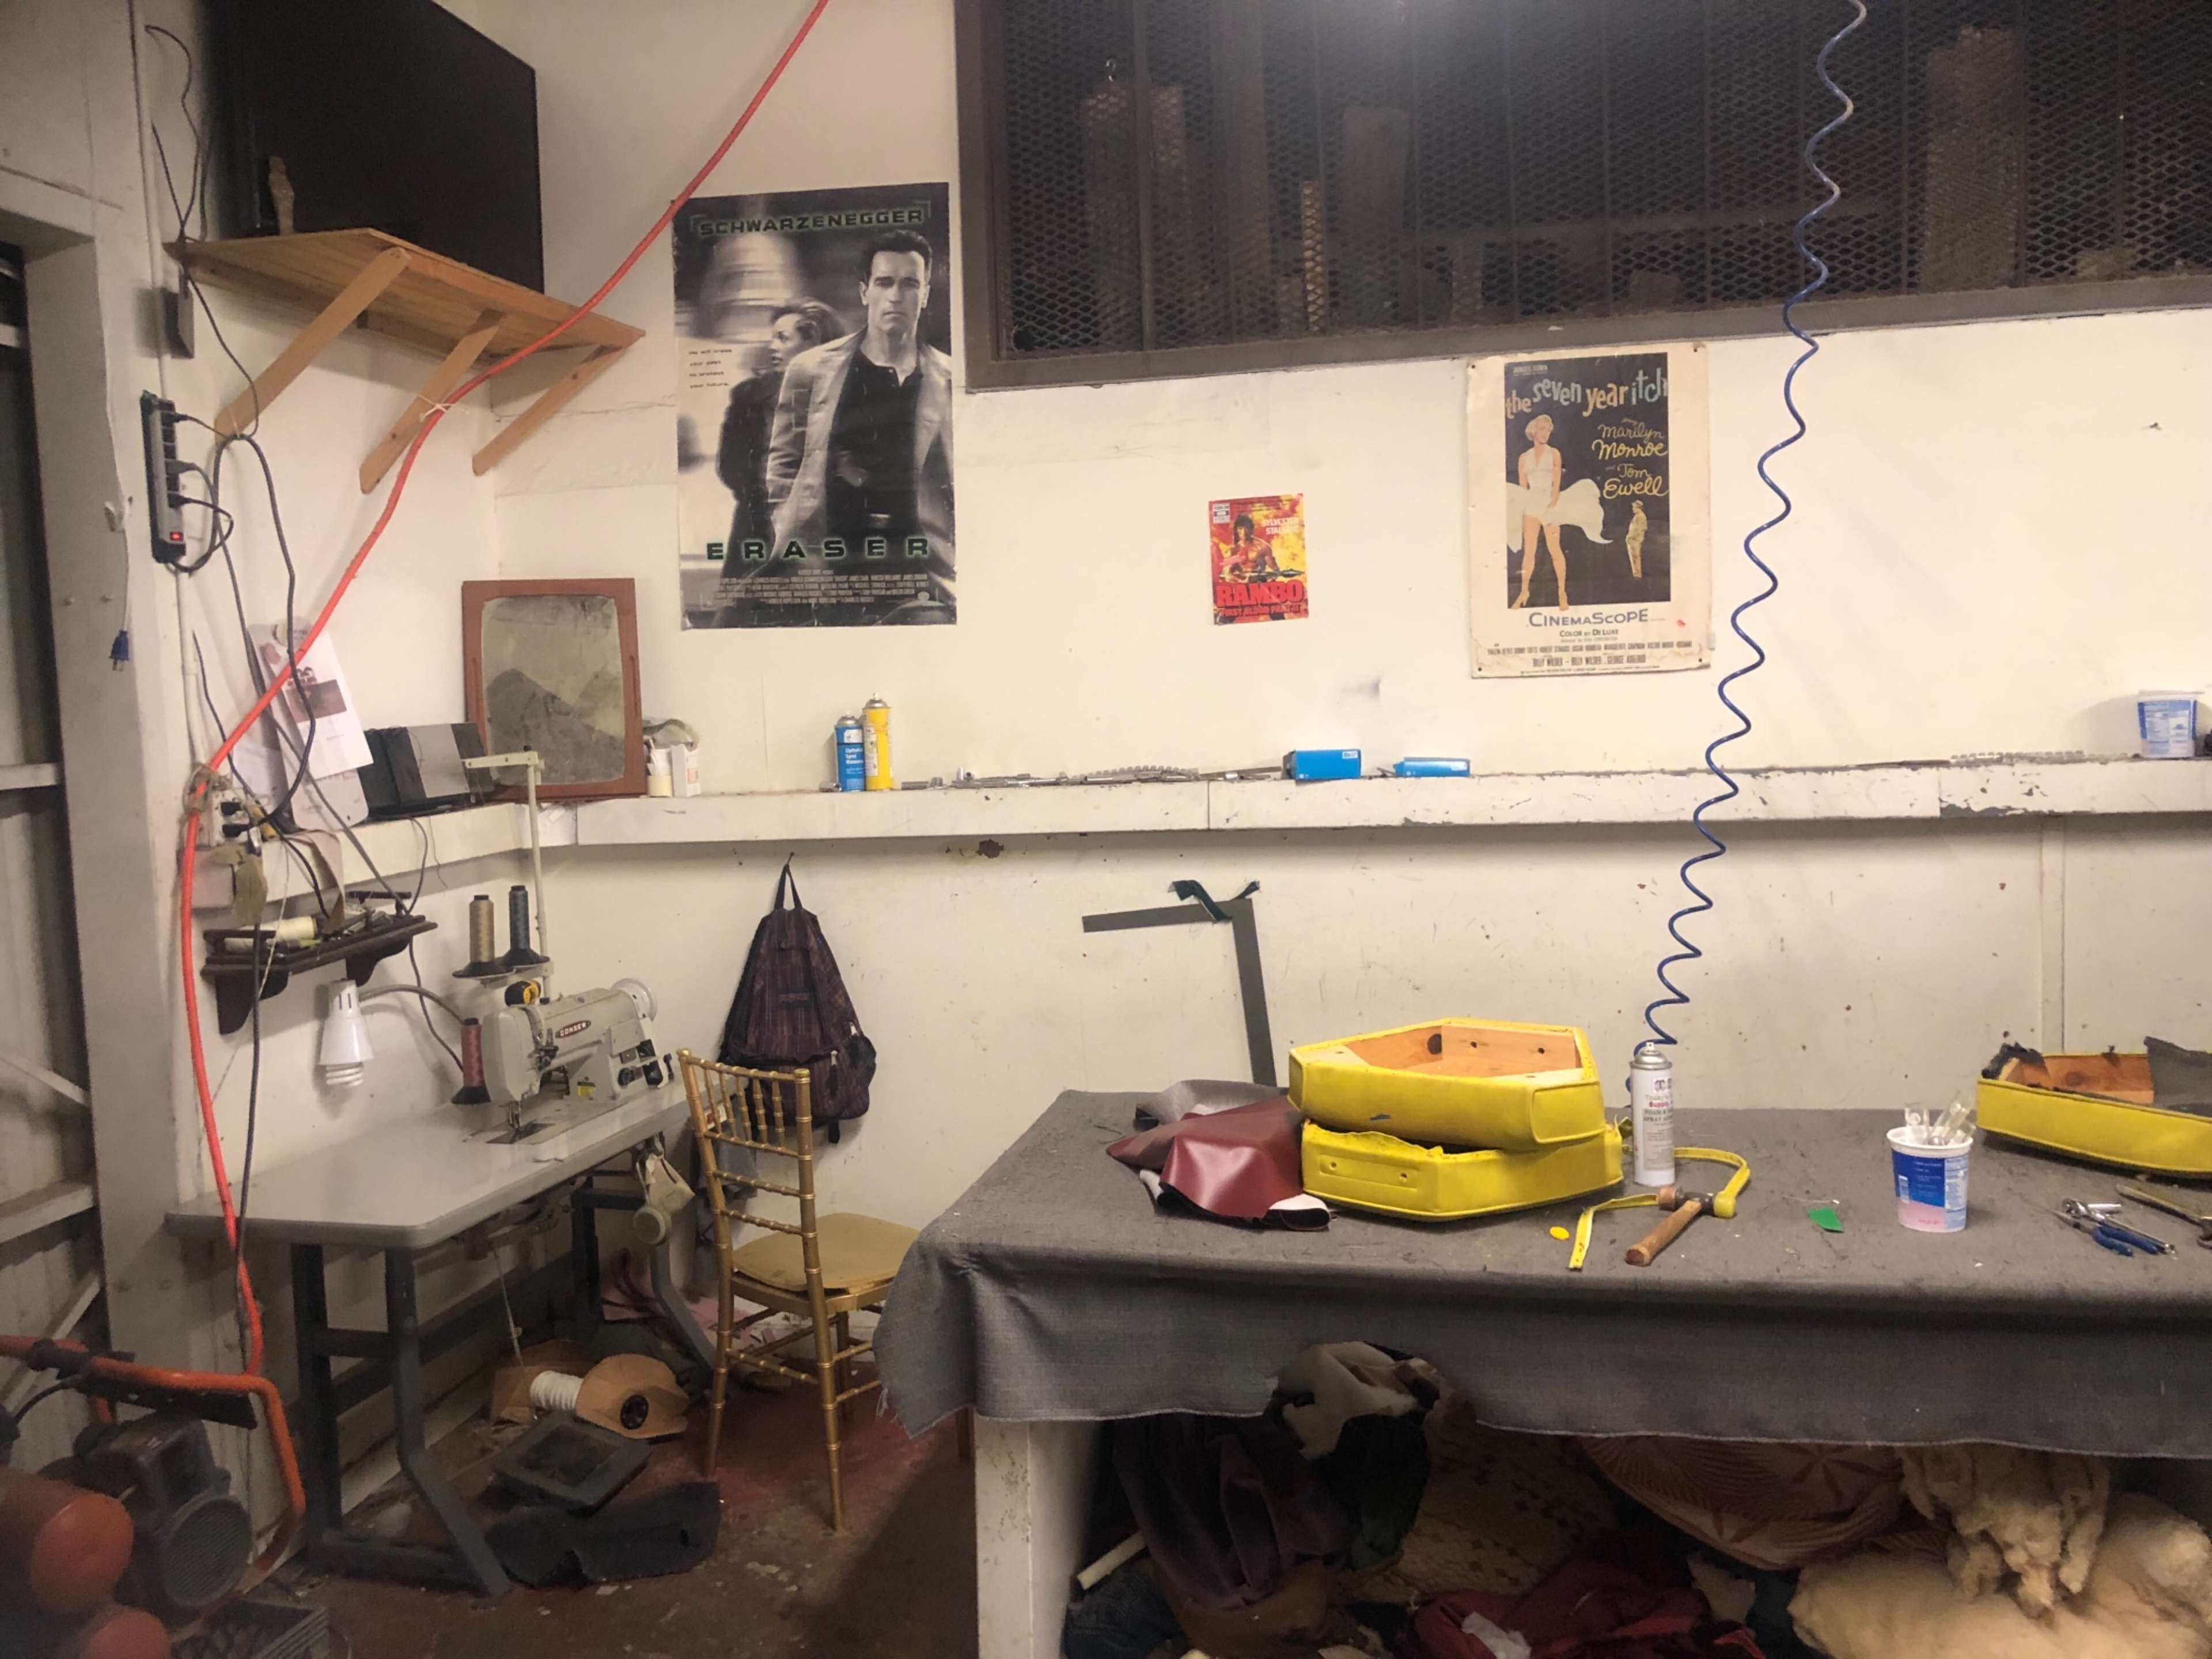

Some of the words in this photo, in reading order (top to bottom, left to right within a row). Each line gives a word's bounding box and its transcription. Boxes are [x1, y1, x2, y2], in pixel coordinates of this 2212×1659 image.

[700, 209, 922, 236] SCHWARZENEGGER
[1506, 390, 1532, 419] the
[1532, 378, 1581, 406] seven
[1582, 383, 1628, 417] year
[1631, 367, 1668, 405] itch
[1597, 422, 1664, 444] Marilyn
[1592, 439, 1668, 460] Monroe
[1617, 463, 1651, 478] Tom
[1603, 476, 1669, 499] Ewell
[706, 537, 928, 560] ERASER
[1217, 579, 1304, 608] RAMBO
